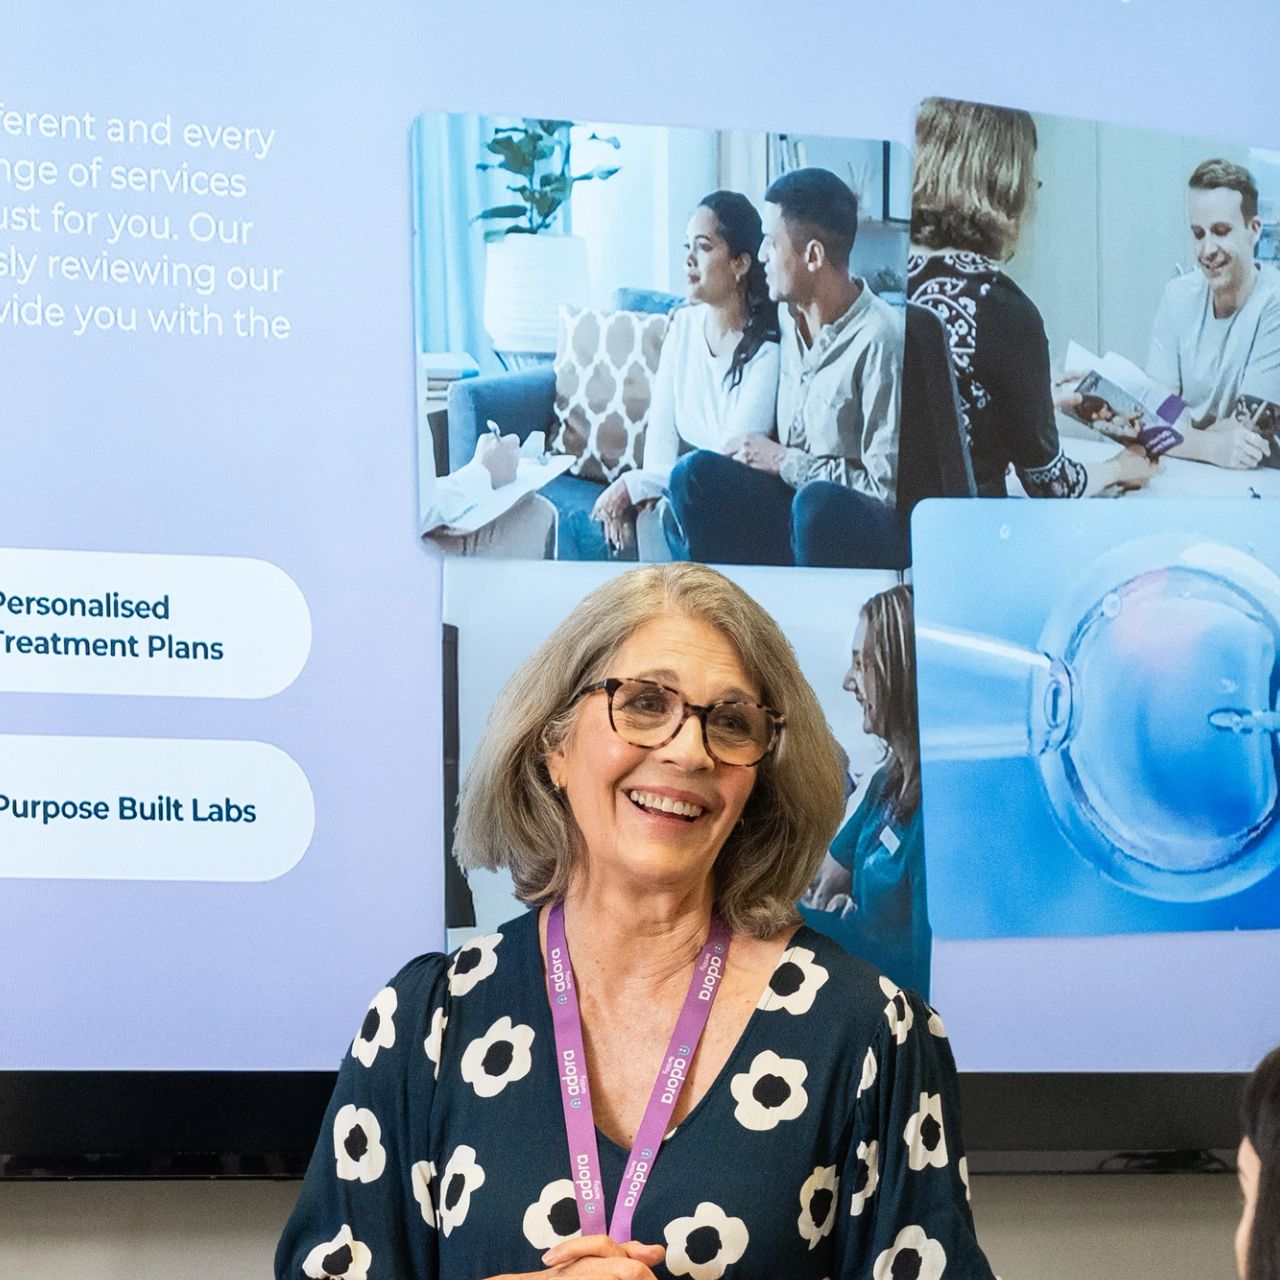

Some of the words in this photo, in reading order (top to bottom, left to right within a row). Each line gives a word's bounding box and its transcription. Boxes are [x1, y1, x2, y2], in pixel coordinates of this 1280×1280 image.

[106, 114, 172, 146] and
[182, 123, 276, 161] every
[67, 155, 104, 189] of
[110, 161, 248, 199] services
[50, 198, 100, 236] for
[106, 212, 179, 245] you.
[188, 211, 255, 245] Our
[47, 250, 216, 296] reviewing
[226, 265, 285, 293] our
[72, 304, 137, 337] you
[146, 302, 224, 337] with
[232, 305, 291, 340] the
[147, 633, 224, 661] Plans
[118, 794, 184, 822] Built
[191, 797, 257, 824] Labs
[550, 947, 566, 992] adora
[698, 956, 722, 1001] adora
[561, 1049, 580, 1096] adora
[660, 1058, 686, 1105] adora
[575, 1153, 593, 1200] adora
[623, 1161, 648, 1207] adora
